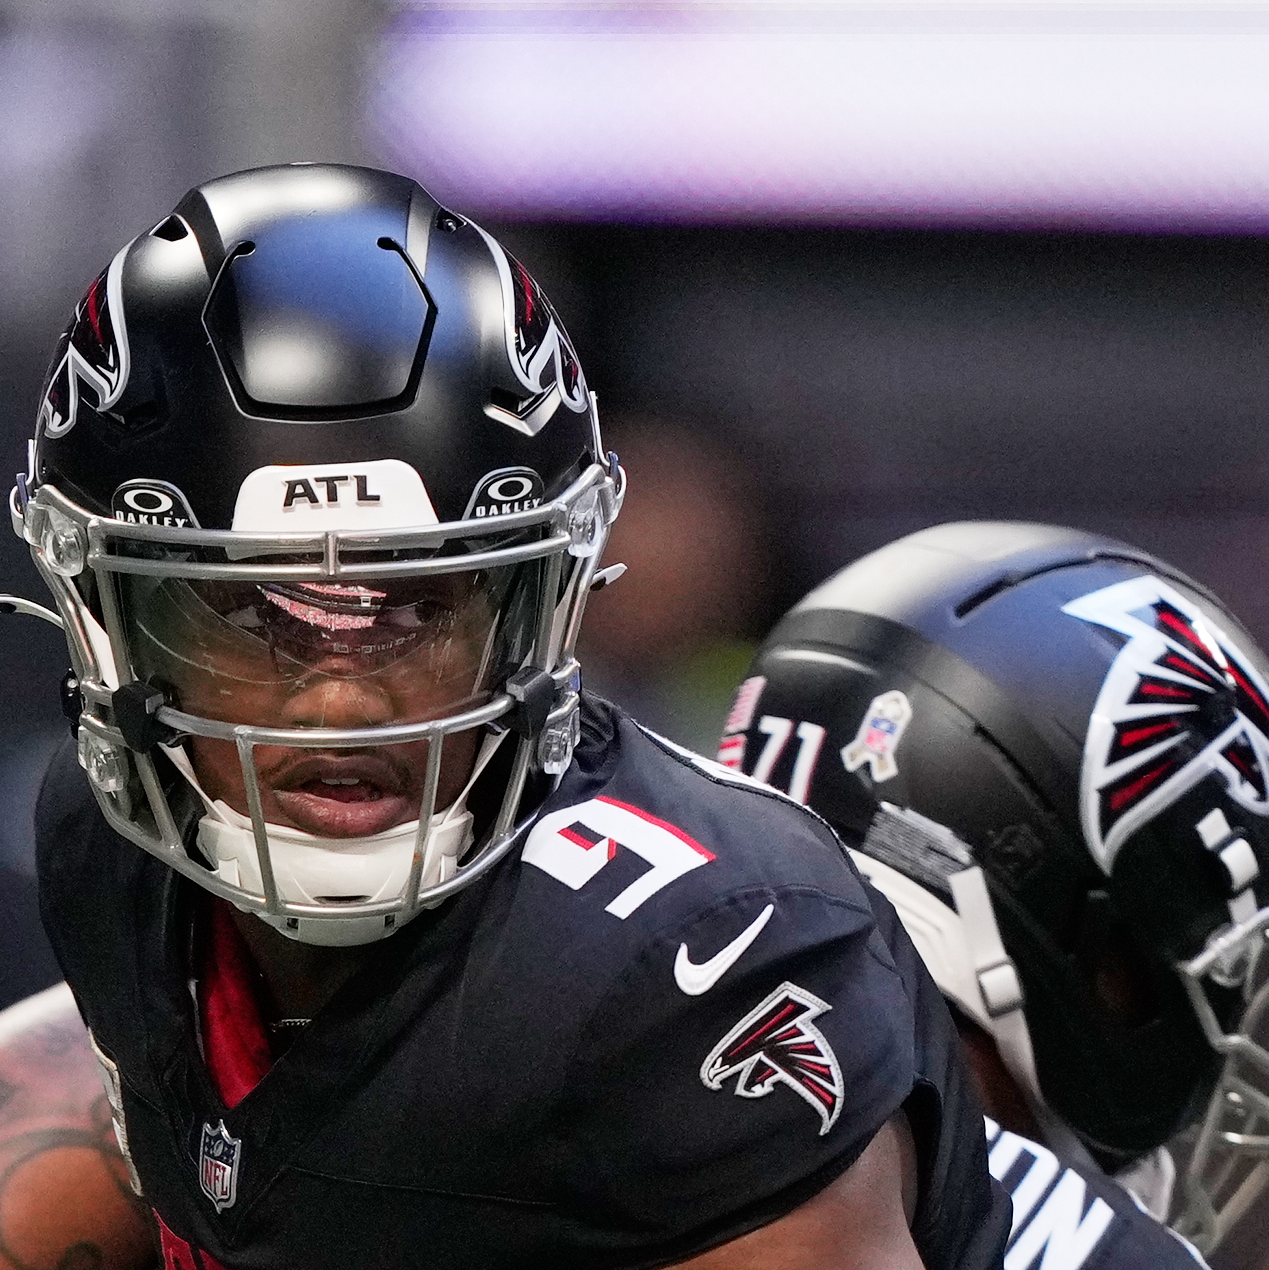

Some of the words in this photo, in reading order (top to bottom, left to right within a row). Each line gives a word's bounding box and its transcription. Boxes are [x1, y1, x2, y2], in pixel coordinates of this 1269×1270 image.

[282, 475, 382, 510] ATL
[475, 498, 541, 517] OAKLEY
[115, 510, 187, 528] OAKLEY
[751, 714, 827, 805] 71
[521, 795, 717, 920] 9
[204, 1159, 228, 1197] NFL
